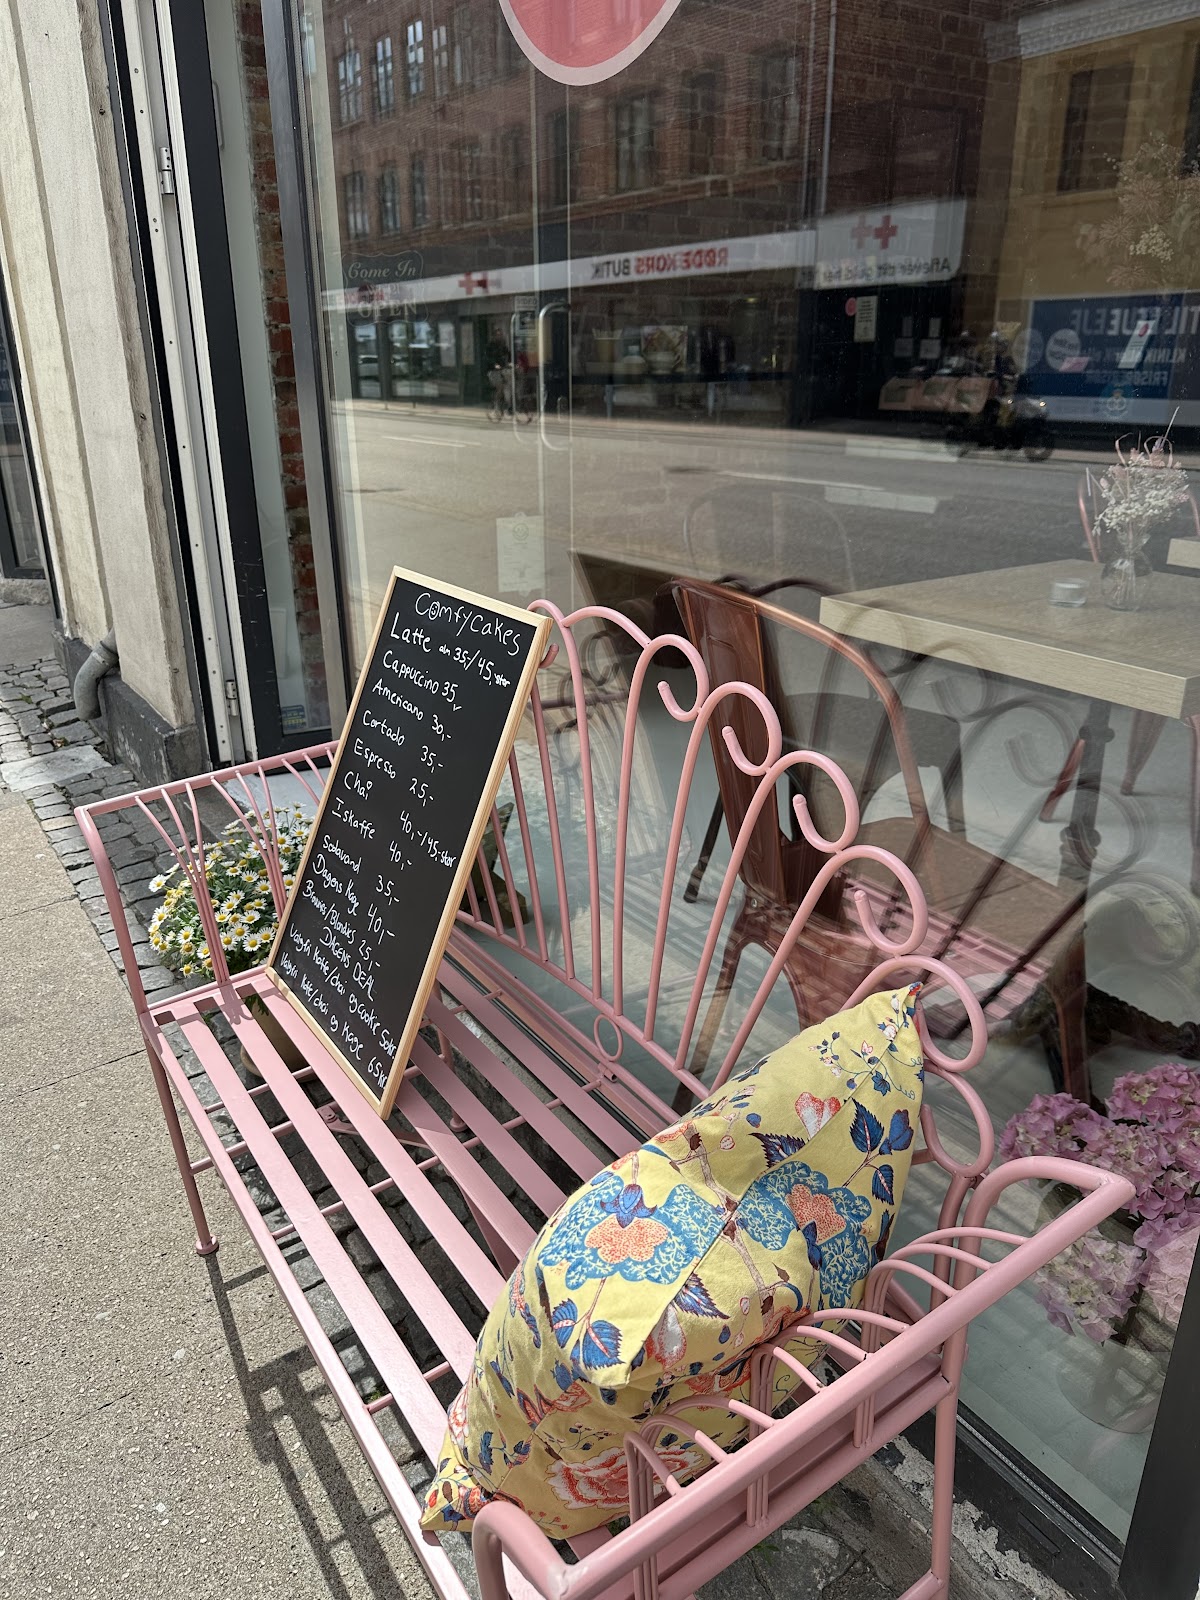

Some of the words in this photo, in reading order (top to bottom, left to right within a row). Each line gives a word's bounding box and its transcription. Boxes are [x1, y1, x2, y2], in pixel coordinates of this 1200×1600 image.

[347, 261, 392, 280] Come
[394, 259, 417, 278] In
[357, 299, 417, 319] OPEN
[390, 612, 431, 652] Latte
[382, 650, 439, 694] Cappuccino
[372, 678, 424, 721] Americano
[431, 714, 452, 741] 30,-
[362, 709, 405, 746] Cortado
[420, 745, 444, 773] 35,-
[344, 771, 373, 800] Chai
[353, 737, 396, 779] Espresso
[409, 777, 434, 807] 25,-
[331, 797, 376, 839] Iskaffe
[389, 840, 413, 871] 40,-
[322, 834, 362, 875] Sodavand
[375, 874, 400, 906] 35,-
[312, 853, 343, 894] Dagens
[367, 903, 396, 945] 40,-
[319, 926, 351, 968] DAGENS
[352, 961, 375, 1002] DEAL
[358, 939, 380, 971] 25,-
[341, 1021, 364, 1061] Kage
